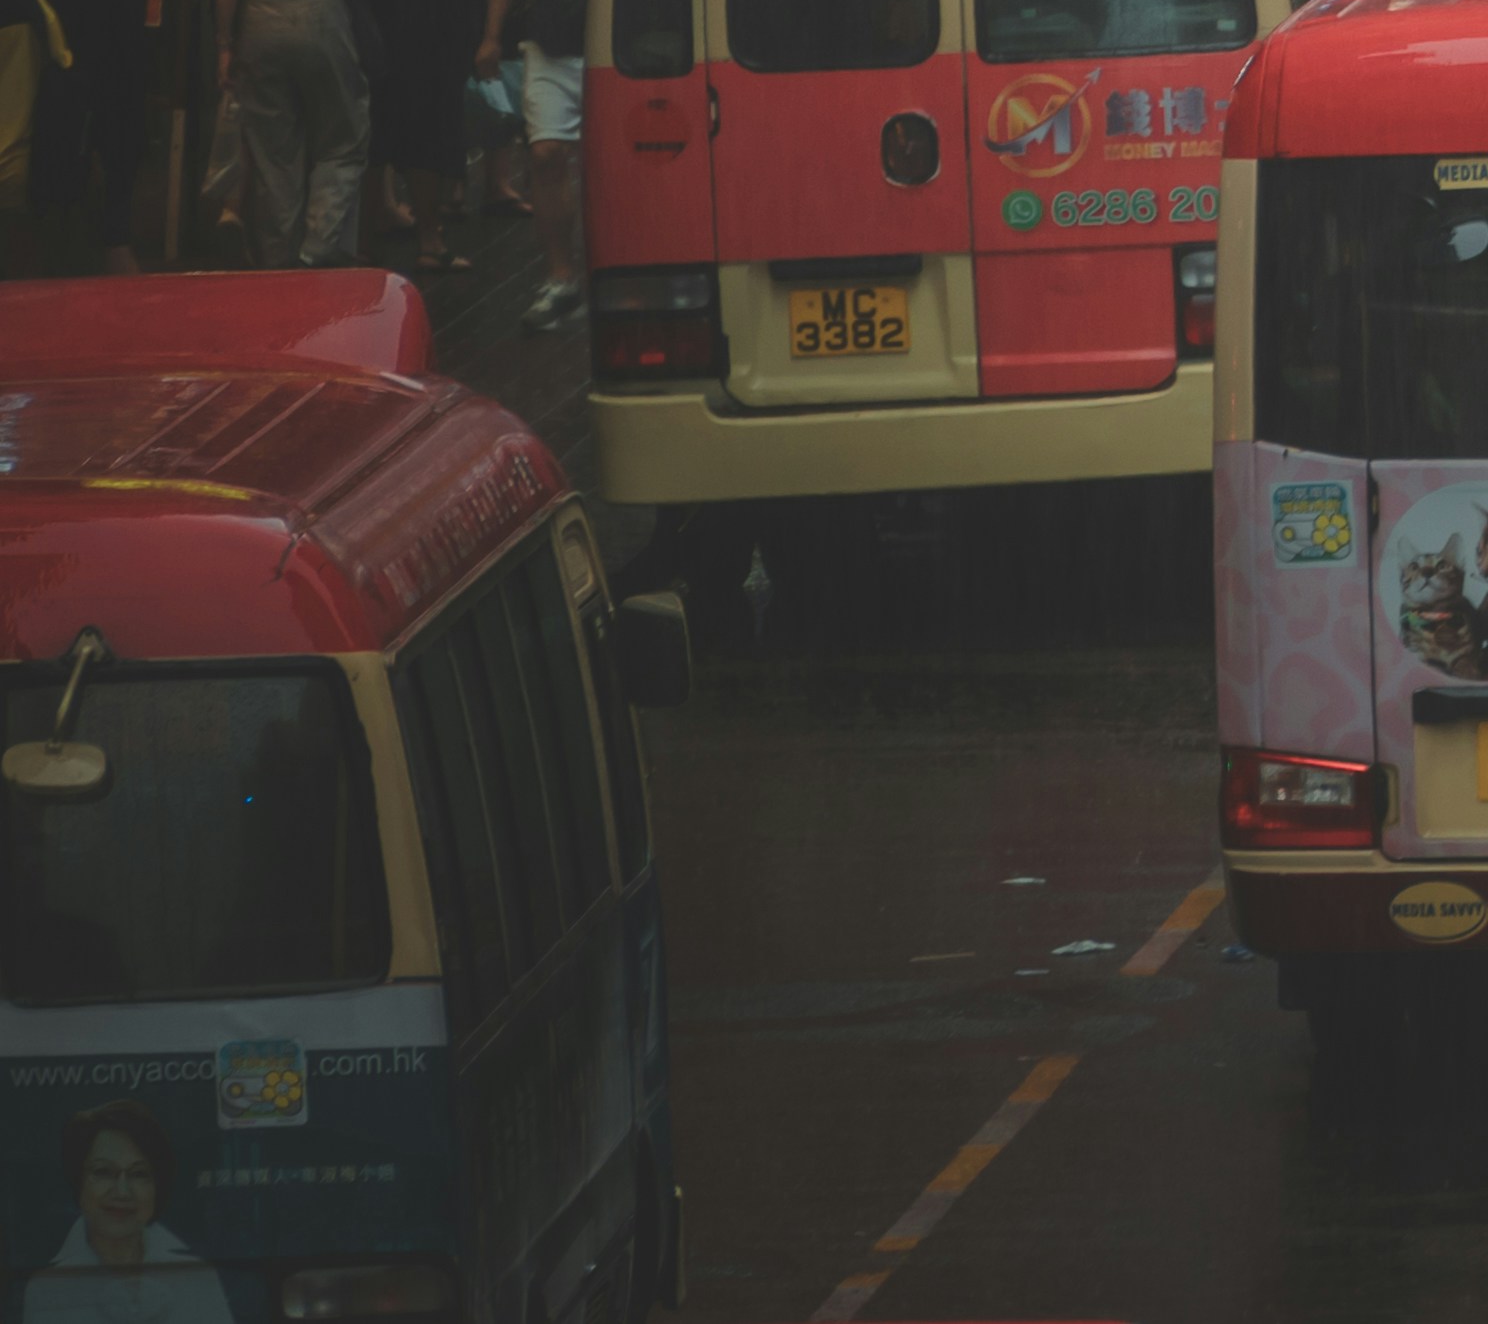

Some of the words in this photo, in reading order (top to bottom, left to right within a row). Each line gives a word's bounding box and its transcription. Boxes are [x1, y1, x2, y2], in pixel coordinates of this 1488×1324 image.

[1052, 187, 1156, 227] 6286
[820, 288, 878, 325] MC
[795, 317, 906, 353] 3382
[1391, 902, 1435, 919] MEDIA
[1439, 900, 1485, 918] SAVVY
[9, 1043, 430, 1090] www.cnyacco.com.hk
